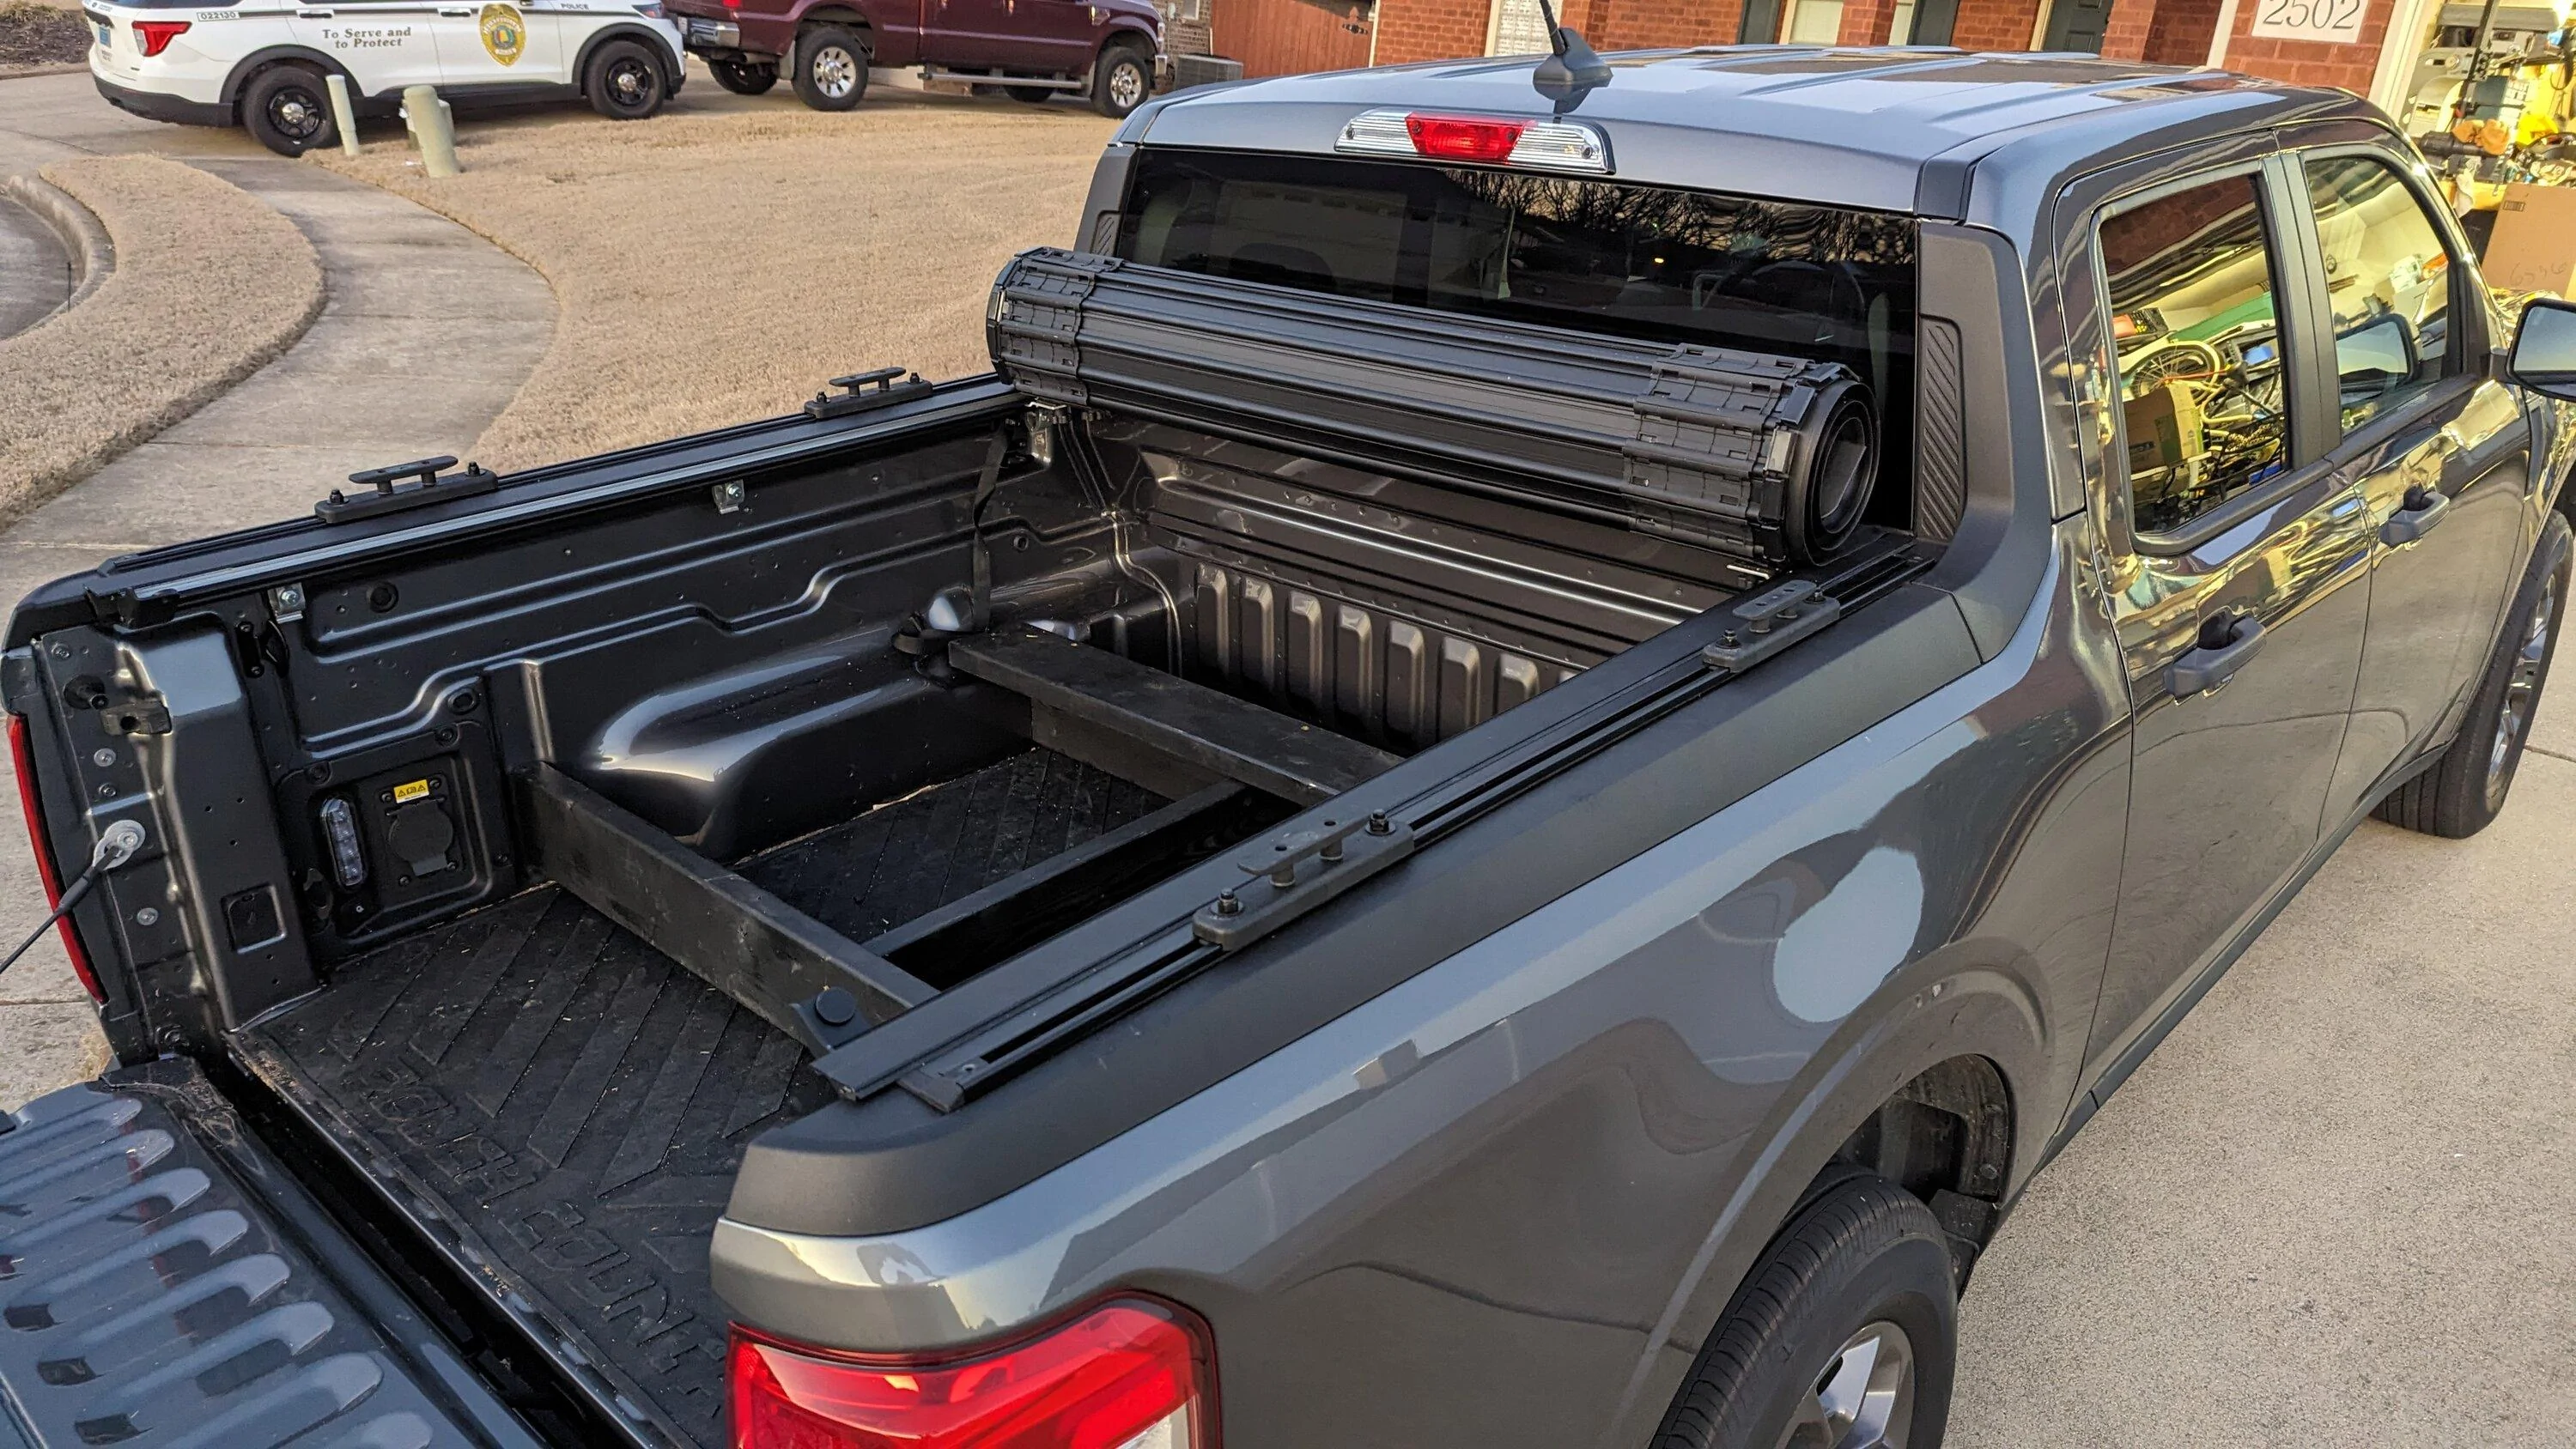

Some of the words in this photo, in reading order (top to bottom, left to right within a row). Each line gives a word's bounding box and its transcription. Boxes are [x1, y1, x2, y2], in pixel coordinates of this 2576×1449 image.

[201, 11, 236, 20] 022130
[2263, 0, 2360, 29] 2502
[322, 29, 339, 39] To
[344, 28, 382, 38] Serve
[387, 26, 411, 37] and
[335, 39, 349, 48] to
[354, 38, 403, 47] Protect
